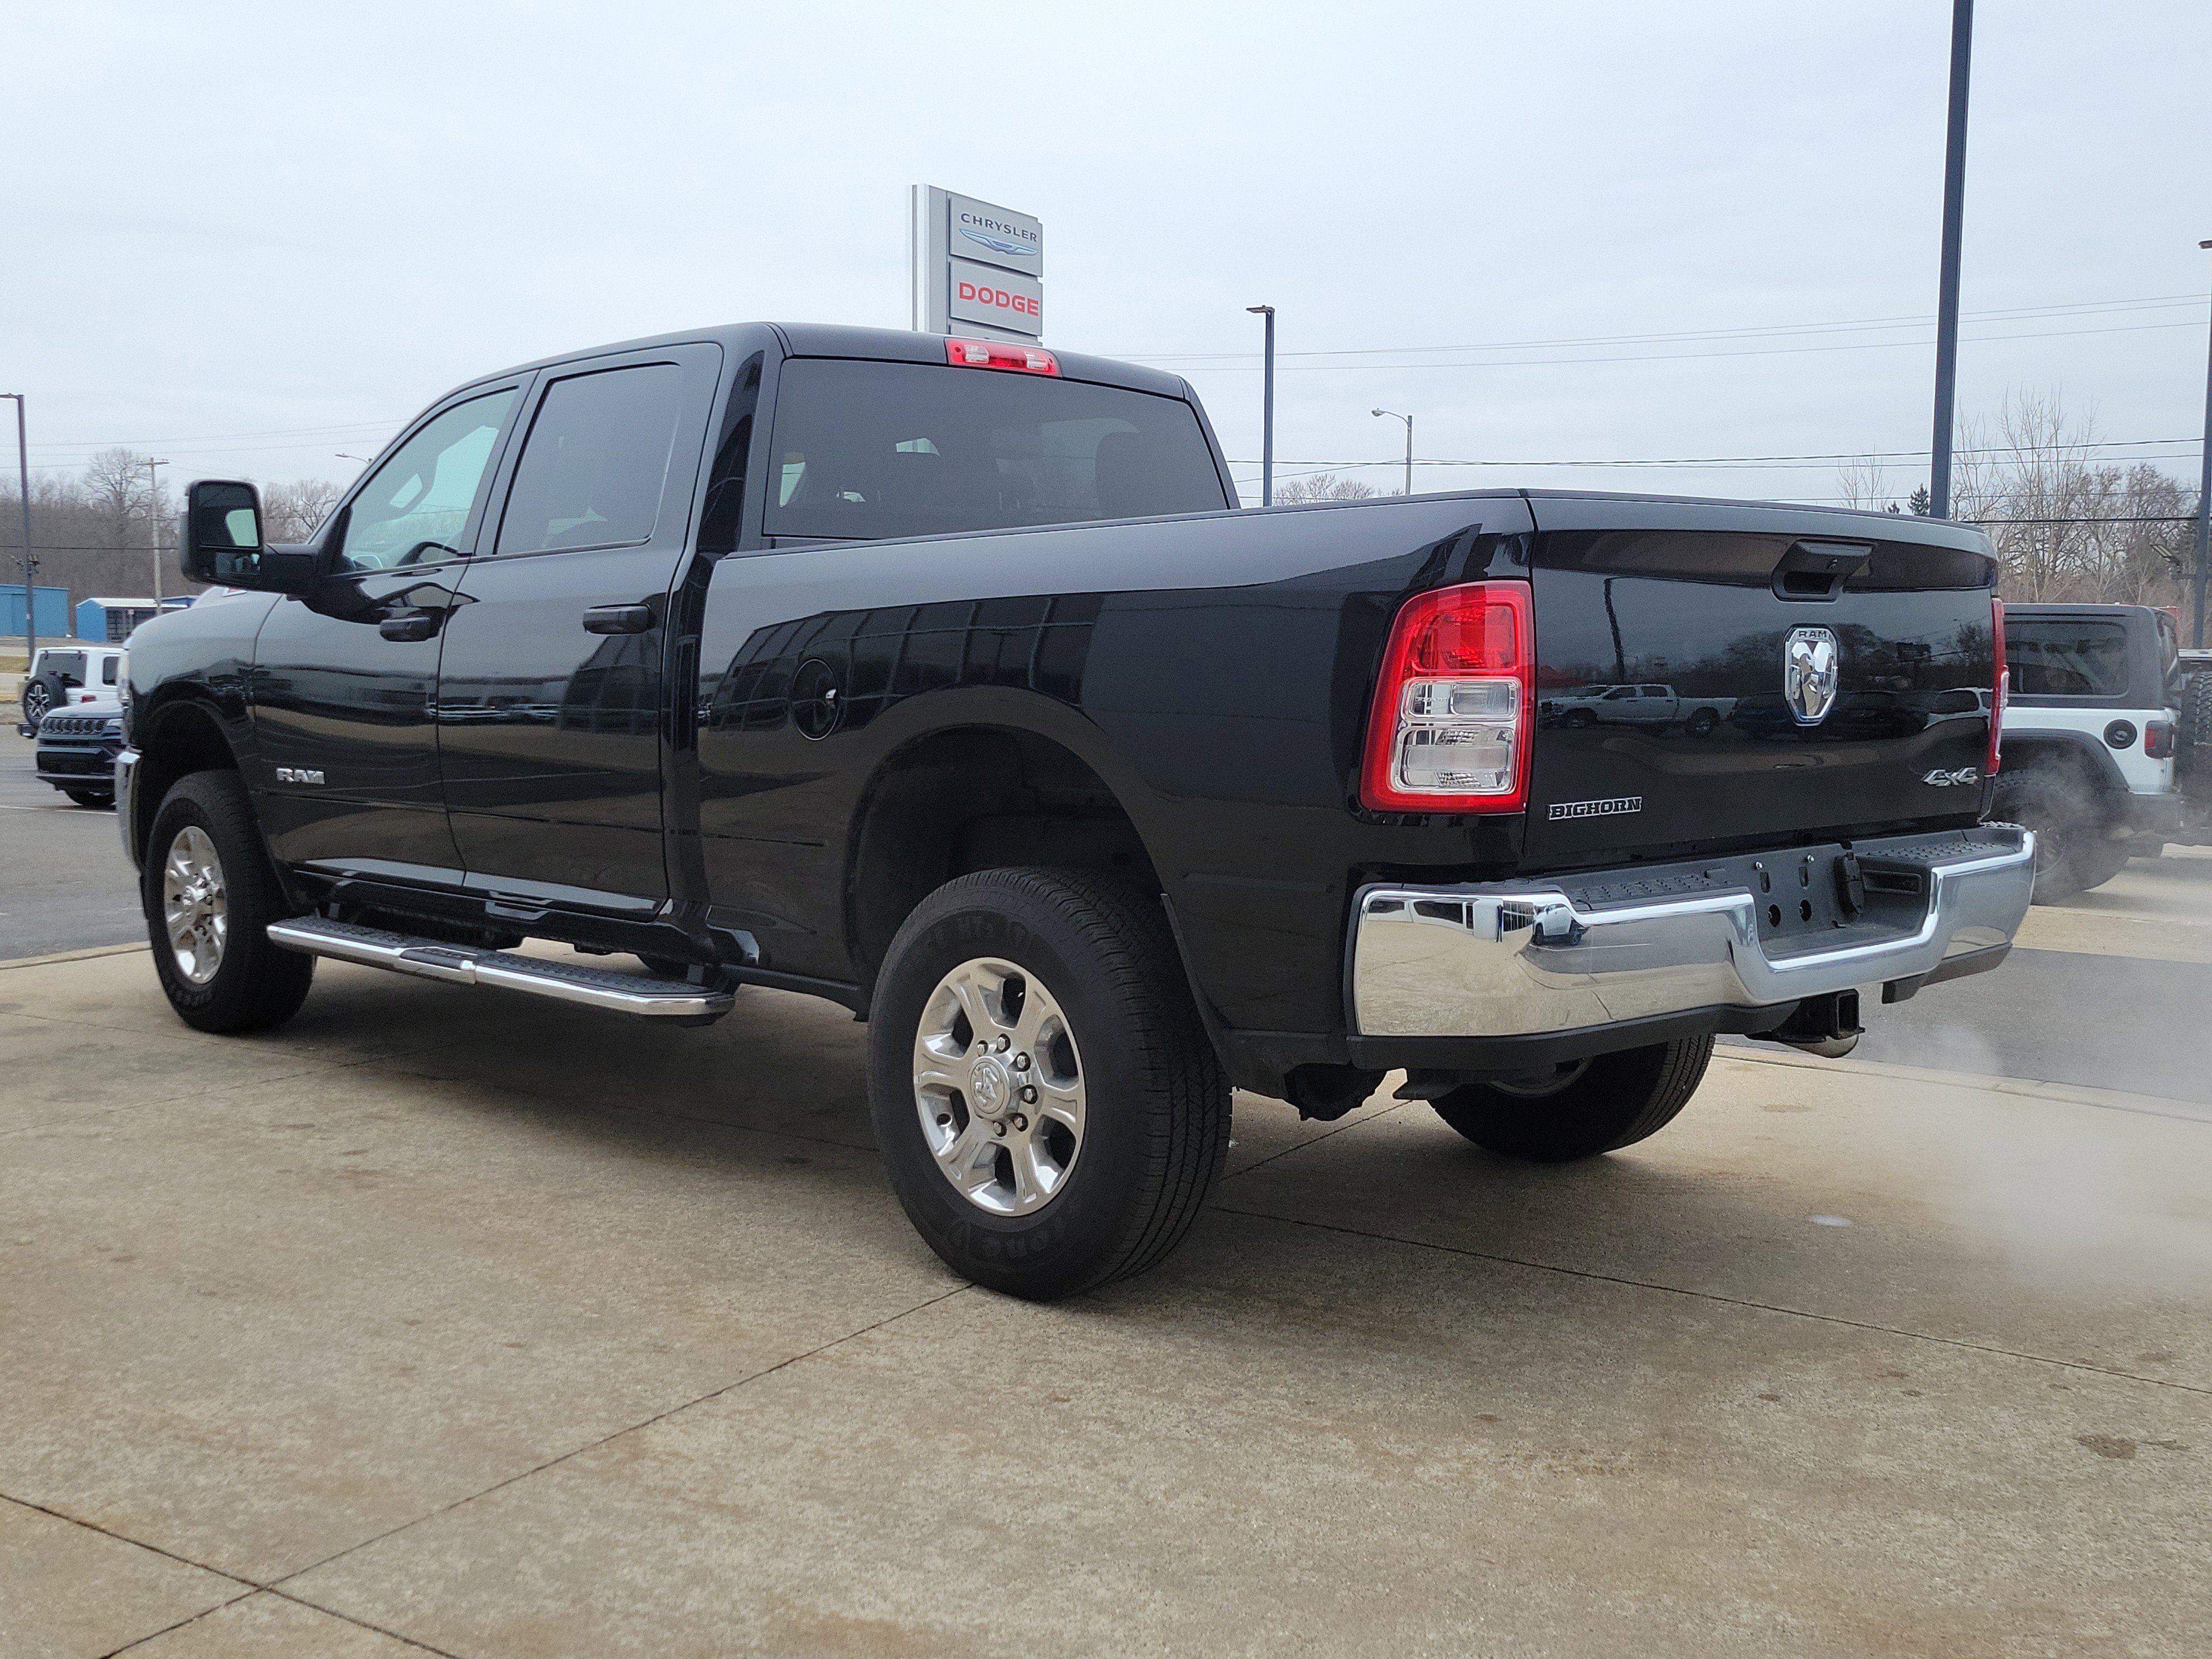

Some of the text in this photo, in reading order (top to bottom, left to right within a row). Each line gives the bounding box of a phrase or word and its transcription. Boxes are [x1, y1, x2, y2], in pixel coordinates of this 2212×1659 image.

[961, 213, 1037, 242] CHRYSLER
[959, 281, 1039, 317] DODGE
[276, 768, 325, 784] RAM
[1548, 797, 1642, 820] BIGHORN
